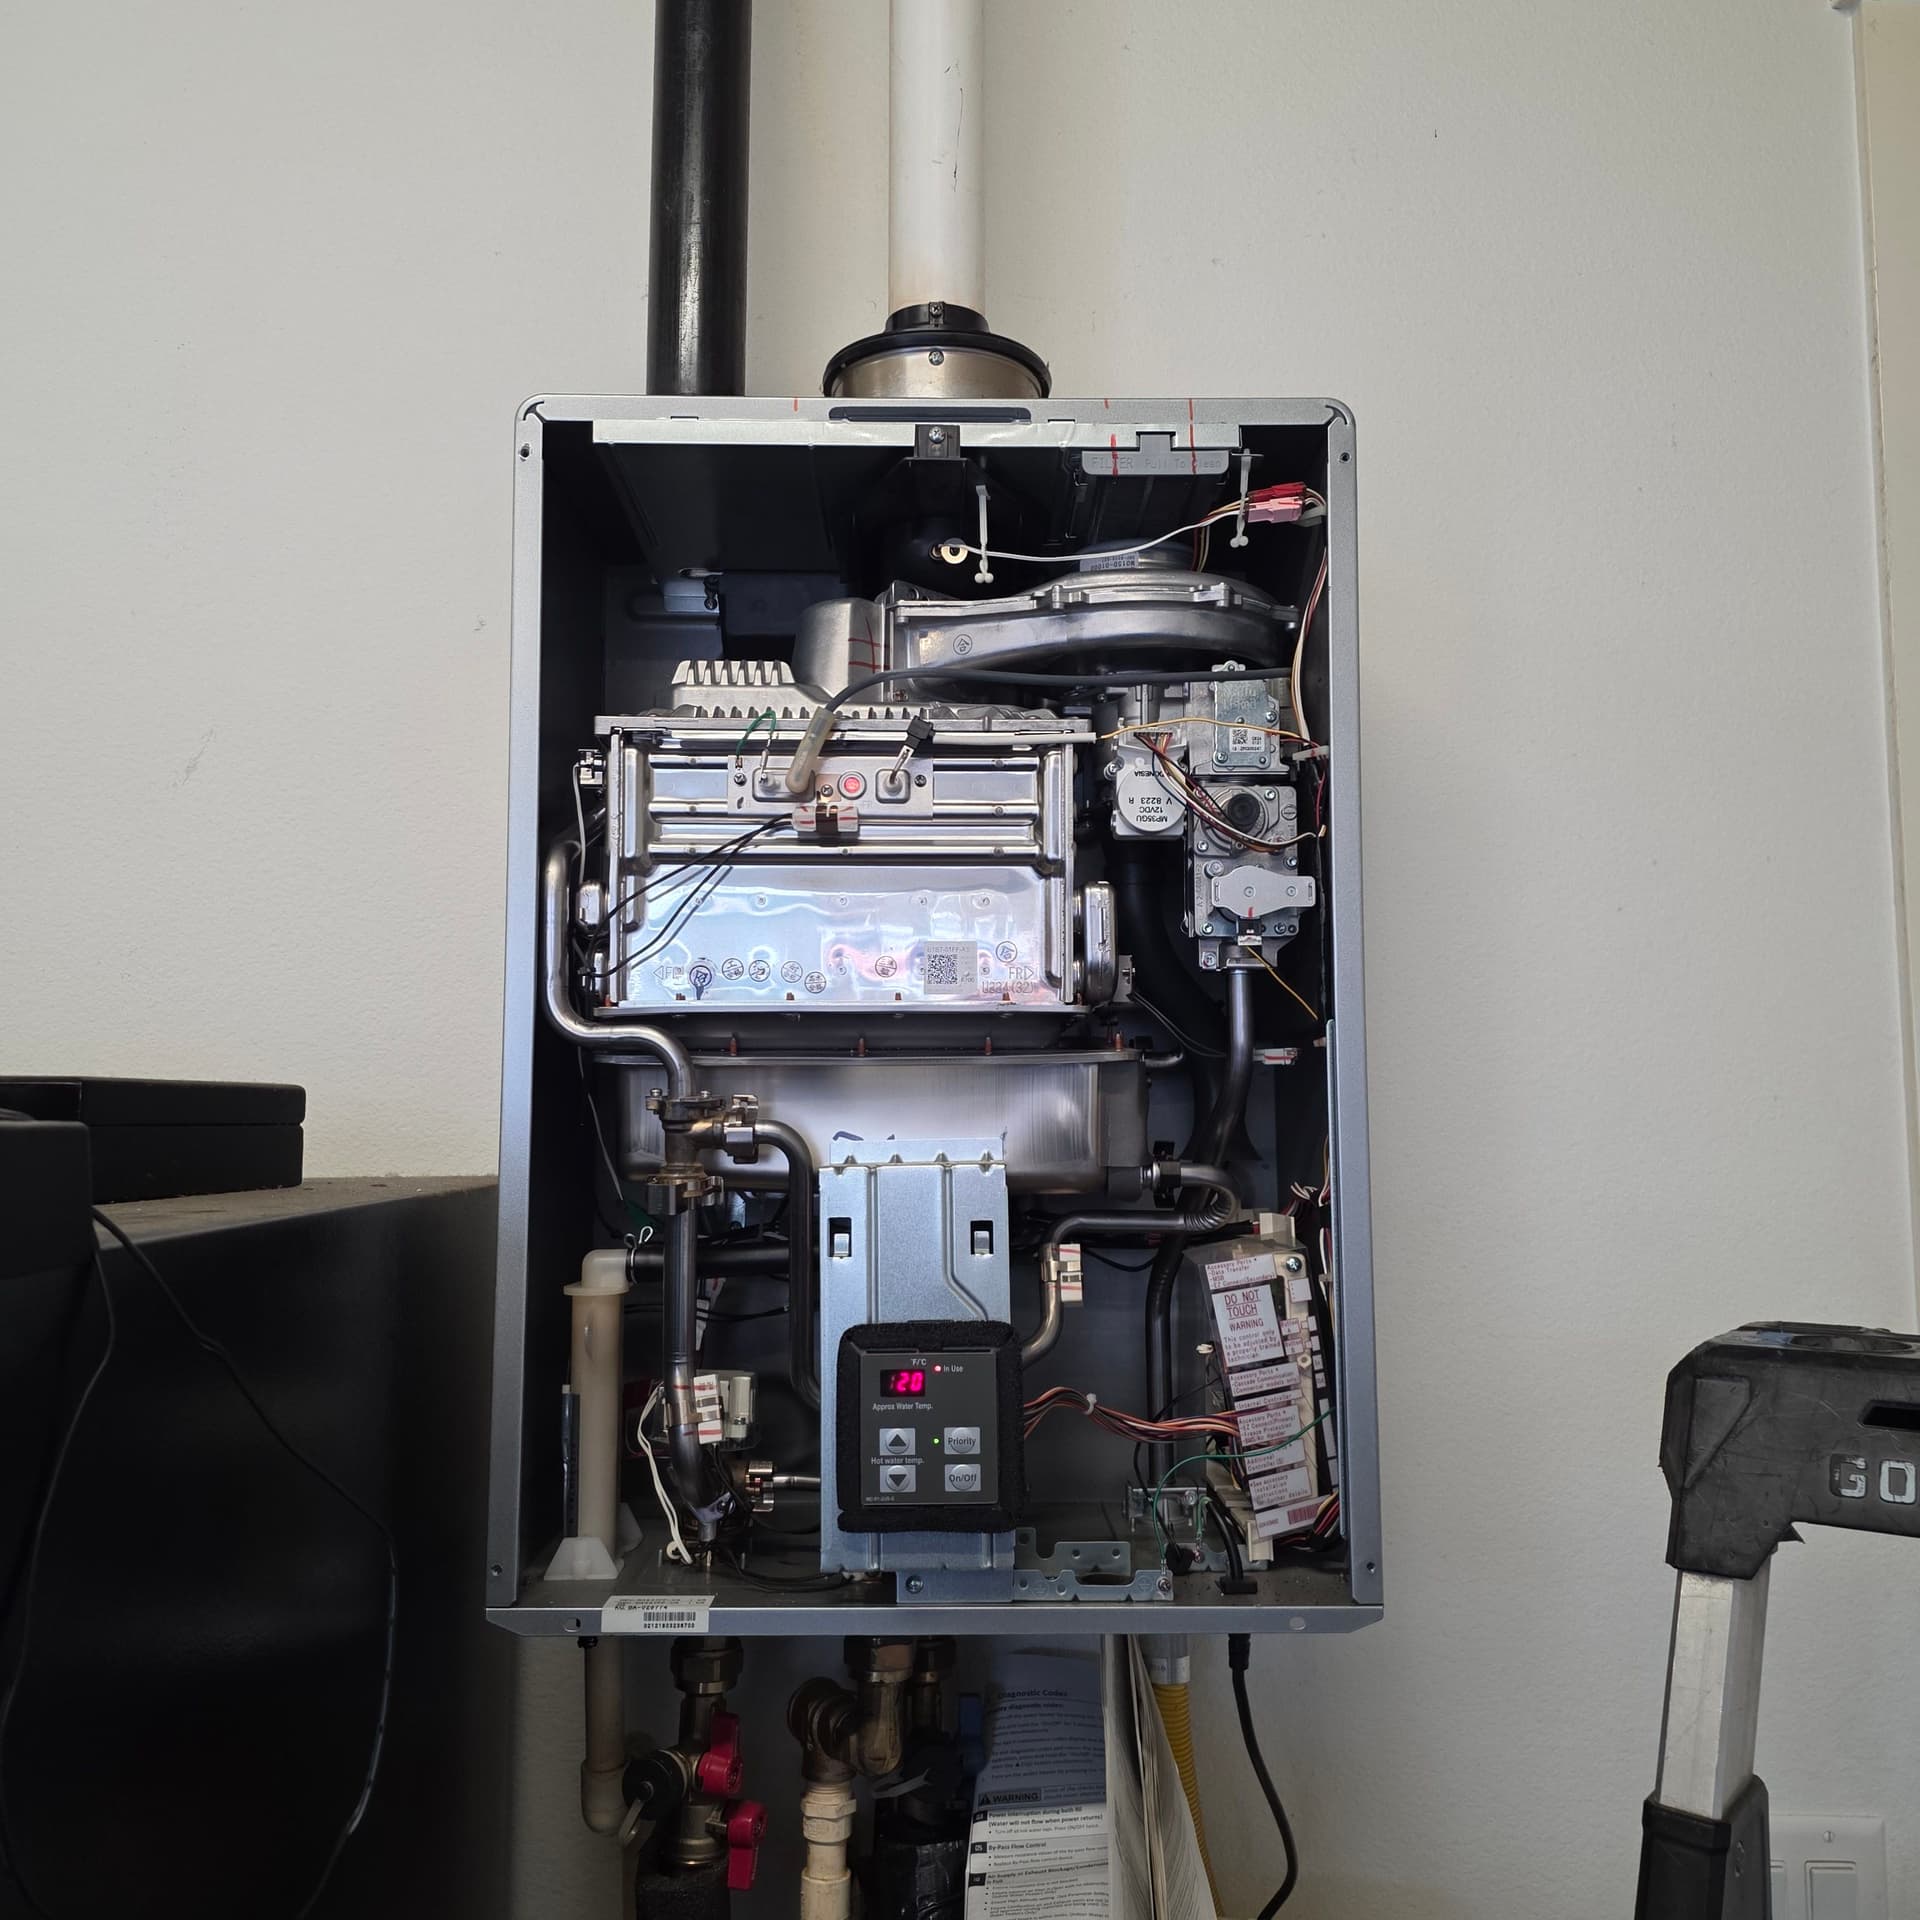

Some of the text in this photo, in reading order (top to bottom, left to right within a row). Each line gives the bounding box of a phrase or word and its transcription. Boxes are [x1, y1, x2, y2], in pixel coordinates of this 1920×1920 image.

[1174, 458, 1186, 469] To
[1224, 1290, 1259, 1304] DO NOT
[1226, 1304, 1258, 1317] TOUCH
[1229, 1319, 1264, 1332] WARNING
[872, 1403, 895, 1411] Approx
[915, 1402, 933, 1411] Temp.
[948, 1435, 976, 1447] Priority
[871, 1456, 883, 1465] Hot
[905, 1456, 924, 1465] temp.
[949, 1473, 977, 1483] On/Off
[1829, 1453, 1918, 1506] GO
[992, 1793, 1038, 1803] WARNING
